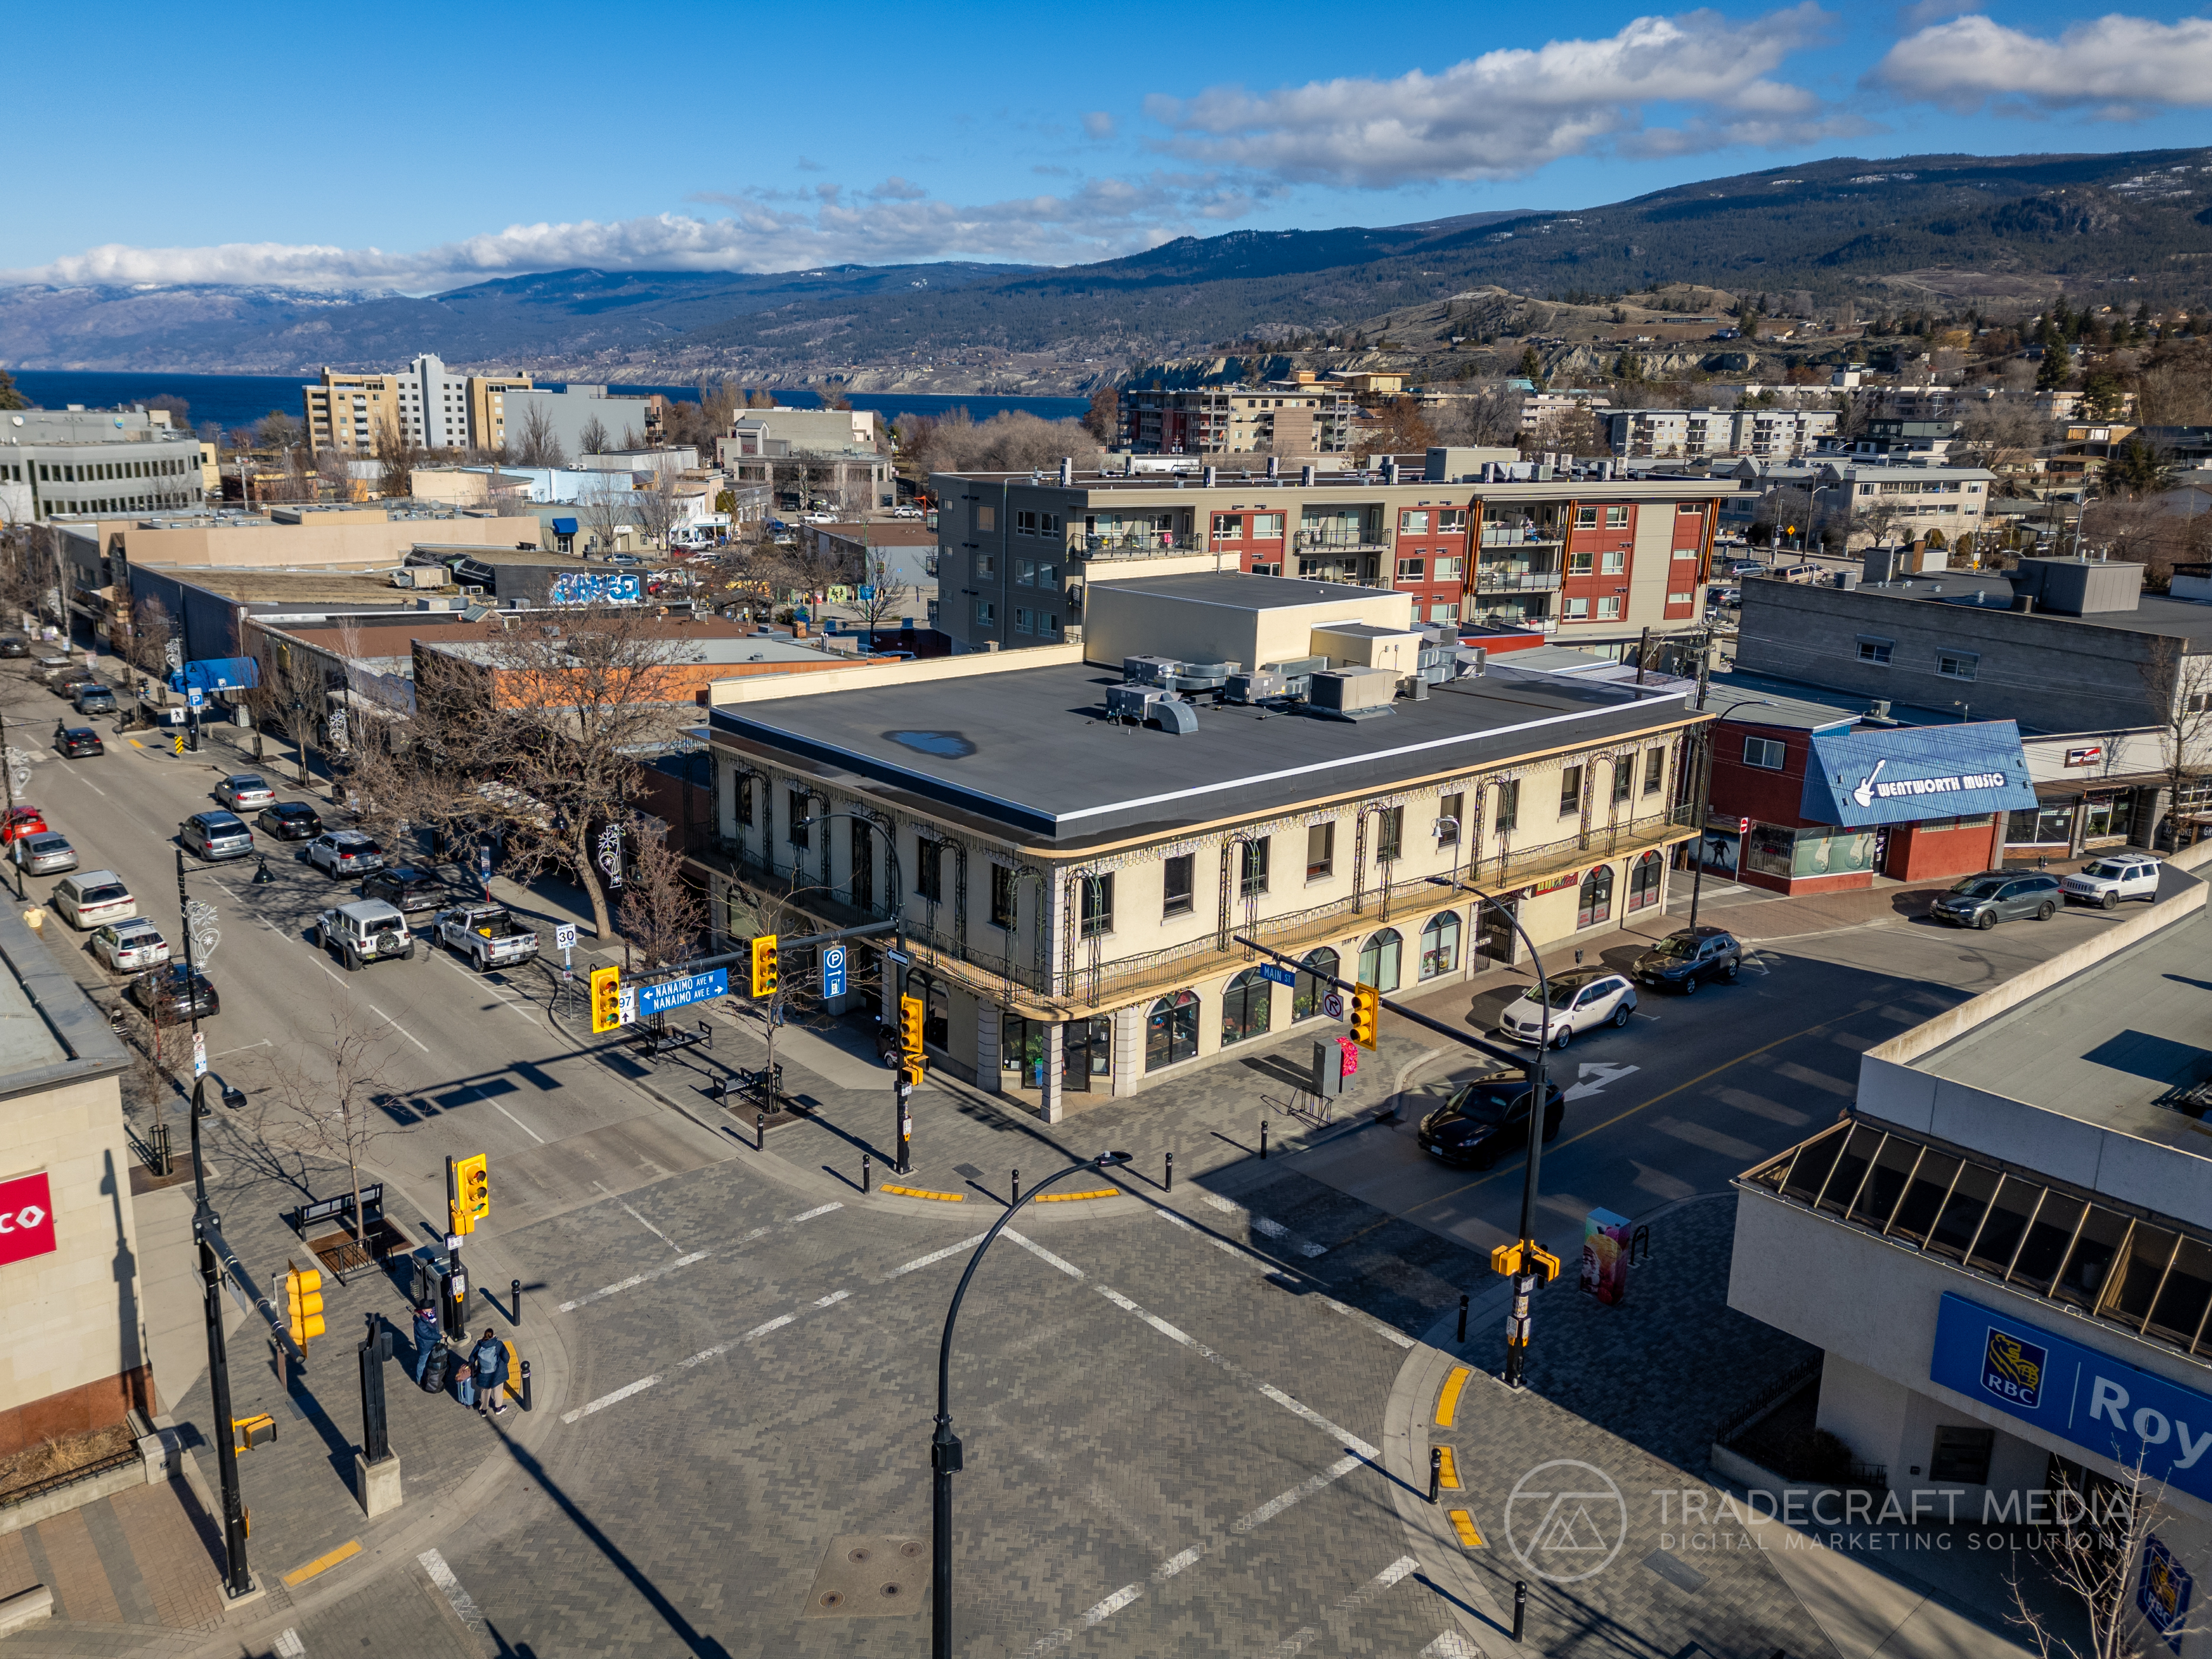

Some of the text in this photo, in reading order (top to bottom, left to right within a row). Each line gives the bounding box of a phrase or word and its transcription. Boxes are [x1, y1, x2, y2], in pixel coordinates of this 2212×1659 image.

[192, 695, 200, 705] P
[1877, 773, 2004, 797] WENTWORTH MUSIC
[2166, 824, 2192, 837] KAOKE
[559, 930, 574, 942] 30
[831, 954, 840, 965] P
[1264, 965, 1291, 983] MAIN ST
[656, 974, 714, 997] NANAIMO AVE W
[619, 996, 631, 1008] 97
[653, 987, 710, 1010] NANAIMO AVE E
[1988, 1373, 2033, 1404] RBC
[2090, 1375, 2212, 1469] Roy
[2148, 1590, 2172, 1626] RBC
